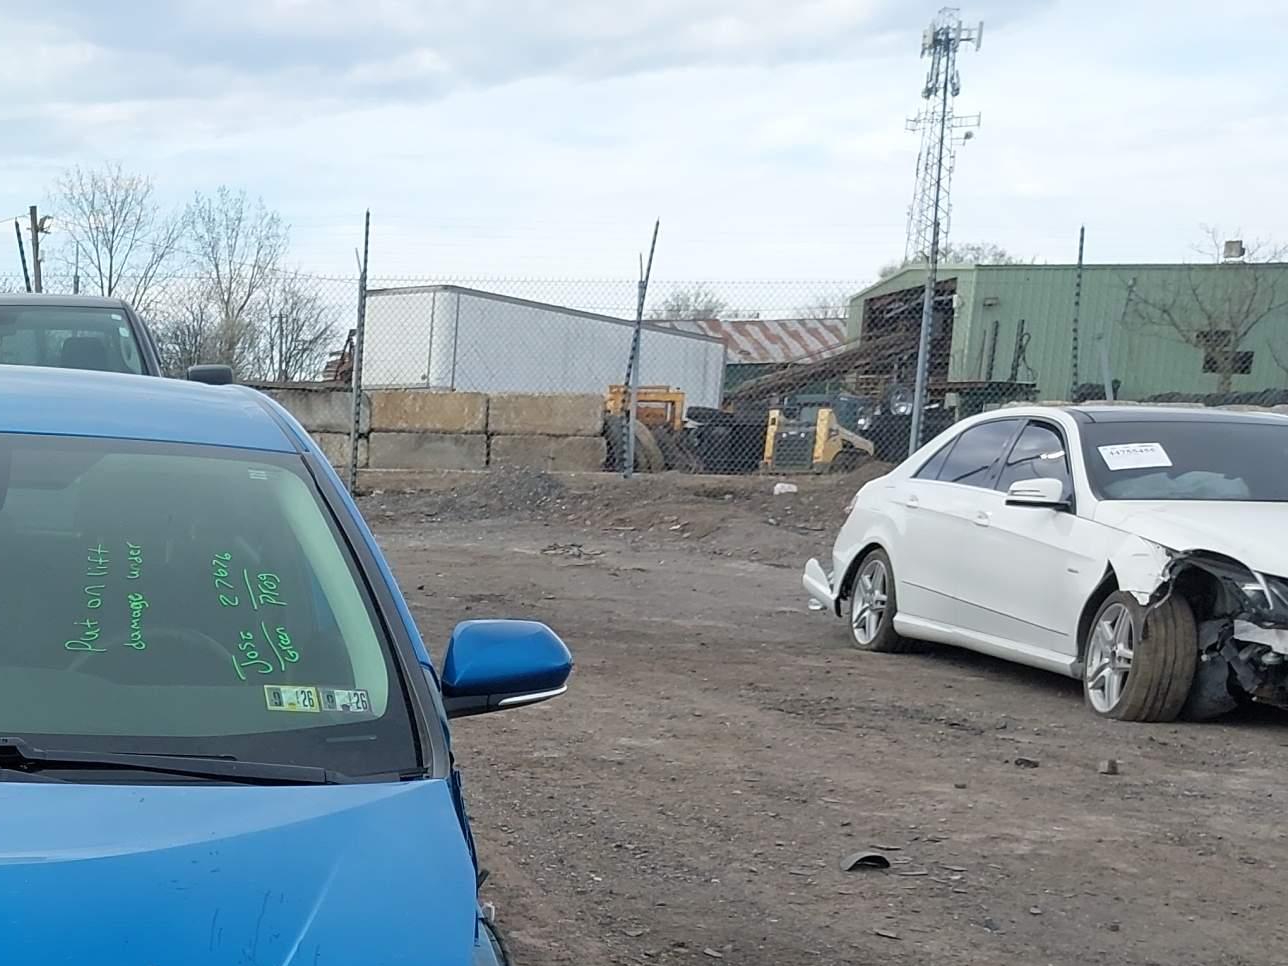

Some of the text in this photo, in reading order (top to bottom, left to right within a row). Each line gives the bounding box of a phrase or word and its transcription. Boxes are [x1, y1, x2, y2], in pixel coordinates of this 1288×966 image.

[64, 543, 110, 652] Put on lift
[300, 690, 315, 708] 26
[353, 692, 369, 710] 26
